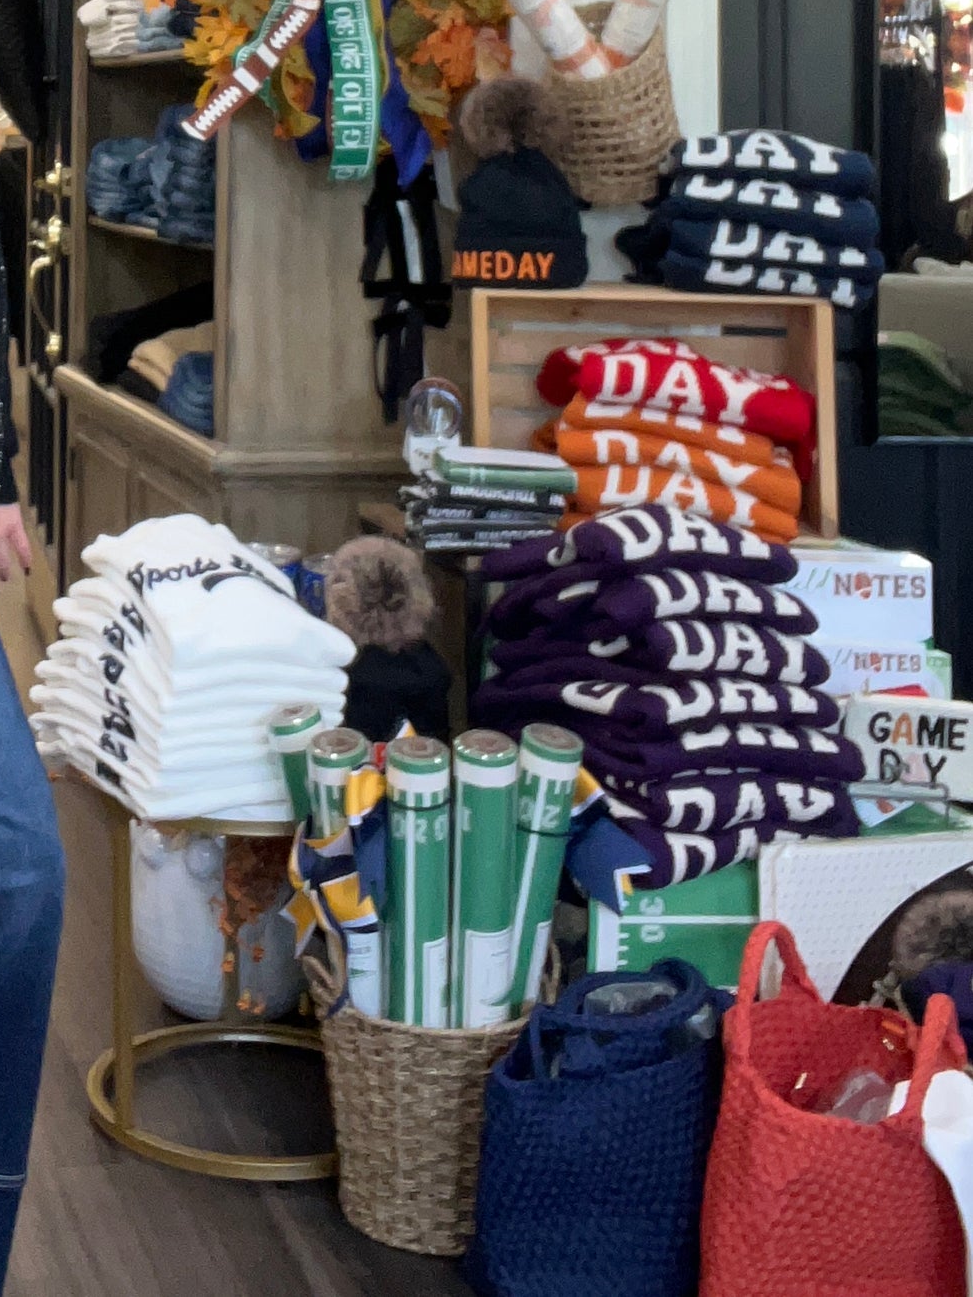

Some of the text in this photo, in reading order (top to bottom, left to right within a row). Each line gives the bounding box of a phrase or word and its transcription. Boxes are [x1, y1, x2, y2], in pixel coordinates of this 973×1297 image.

[340, 81, 363, 115] 10
[682, 131, 845, 175] DAY
[598, 352, 769, 426] DAY
[663, 619, 808, 684] DAY
[869, 711, 969, 751] GAME
